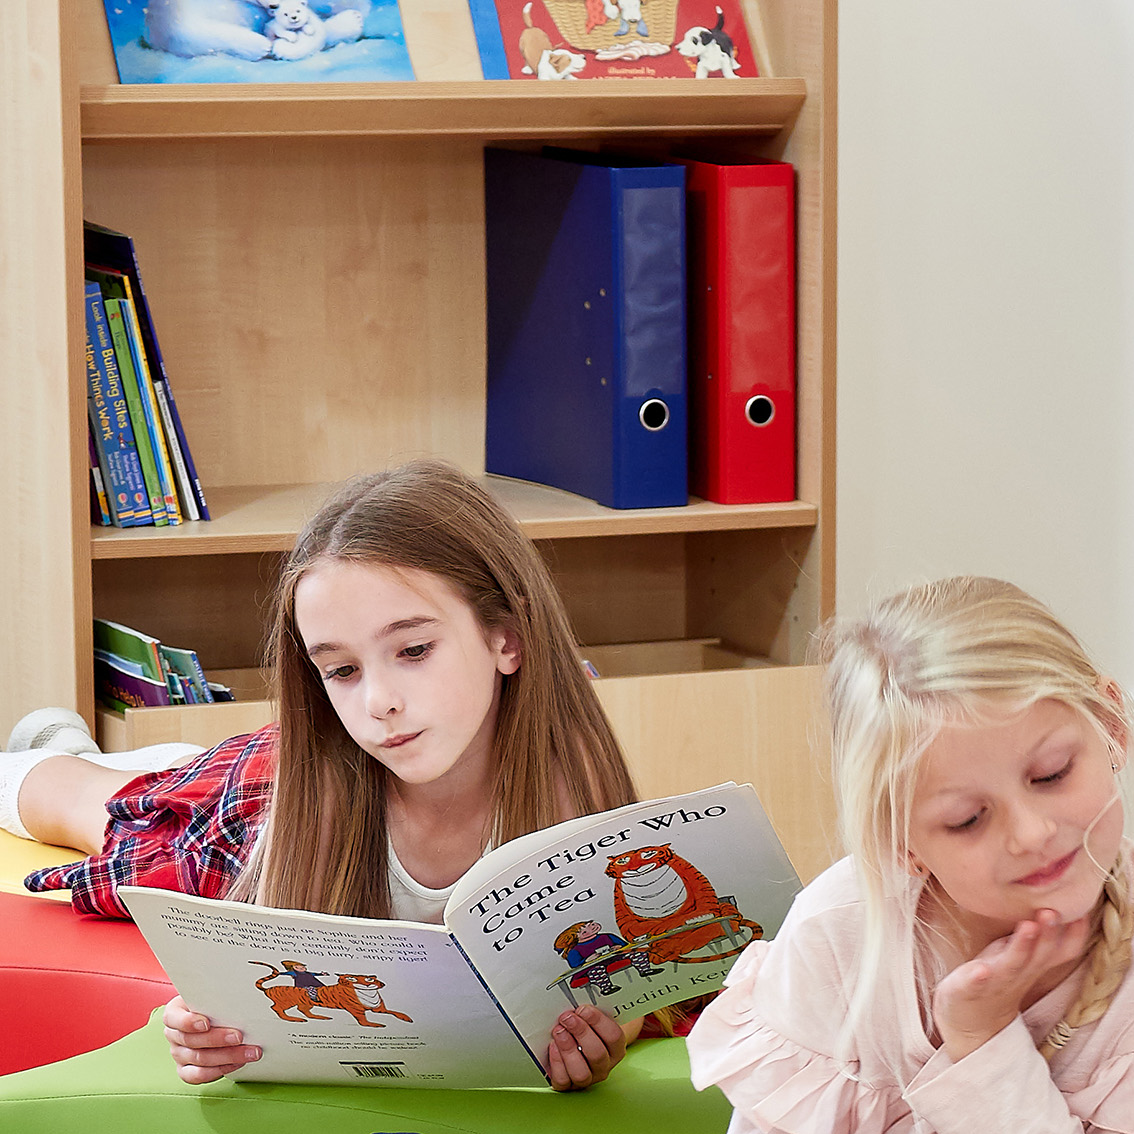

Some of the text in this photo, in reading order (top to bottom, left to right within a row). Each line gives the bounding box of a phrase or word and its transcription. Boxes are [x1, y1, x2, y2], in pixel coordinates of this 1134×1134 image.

[91, 301, 104, 322] Look
[96, 323, 108, 347] inside
[101, 348, 120, 398] Building
[89, 370, 105, 408] Things
[98, 407, 115, 441] Work
[113, 399, 128, 429] Sites
[469, 804, 727, 918] The Tiger Who
[483, 874, 575, 934] Came
[493, 887, 597, 952] to Tea
[160, 913, 206, 927] mummy
[210, 922, 229, 930] are
[232, 926, 268, 937] sitting
[270, 931, 304, 941] down
[307, 934, 320, 942] to
[323, 936, 345, 944] tea.
[348, 939, 377, 947] Who
[380, 941, 414, 949] could
[167, 922, 212, 936] possibly
[238, 933, 269, 943] What
[272, 938, 297, 948] they
[301, 942, 351, 953] certainly
[355, 946, 385, 954] don't
[389, 949, 428, 957] expect
[168, 906, 190, 915] The
[194, 911, 241, 925] doorbell
[245, 921, 273, 930] rings
[277, 924, 297, 933] just
[387, 934, 409, 942] her
[174, 930, 187, 938] to
[190, 933, 209, 941] see
[212, 937, 224, 945] at
[227, 939, 245, 947] the
[249, 942, 276, 951] door
[304, 948, 325, 958] big
[362, 954, 394, 963] stripy
[614, 968, 729, 1019] Judith Ker
